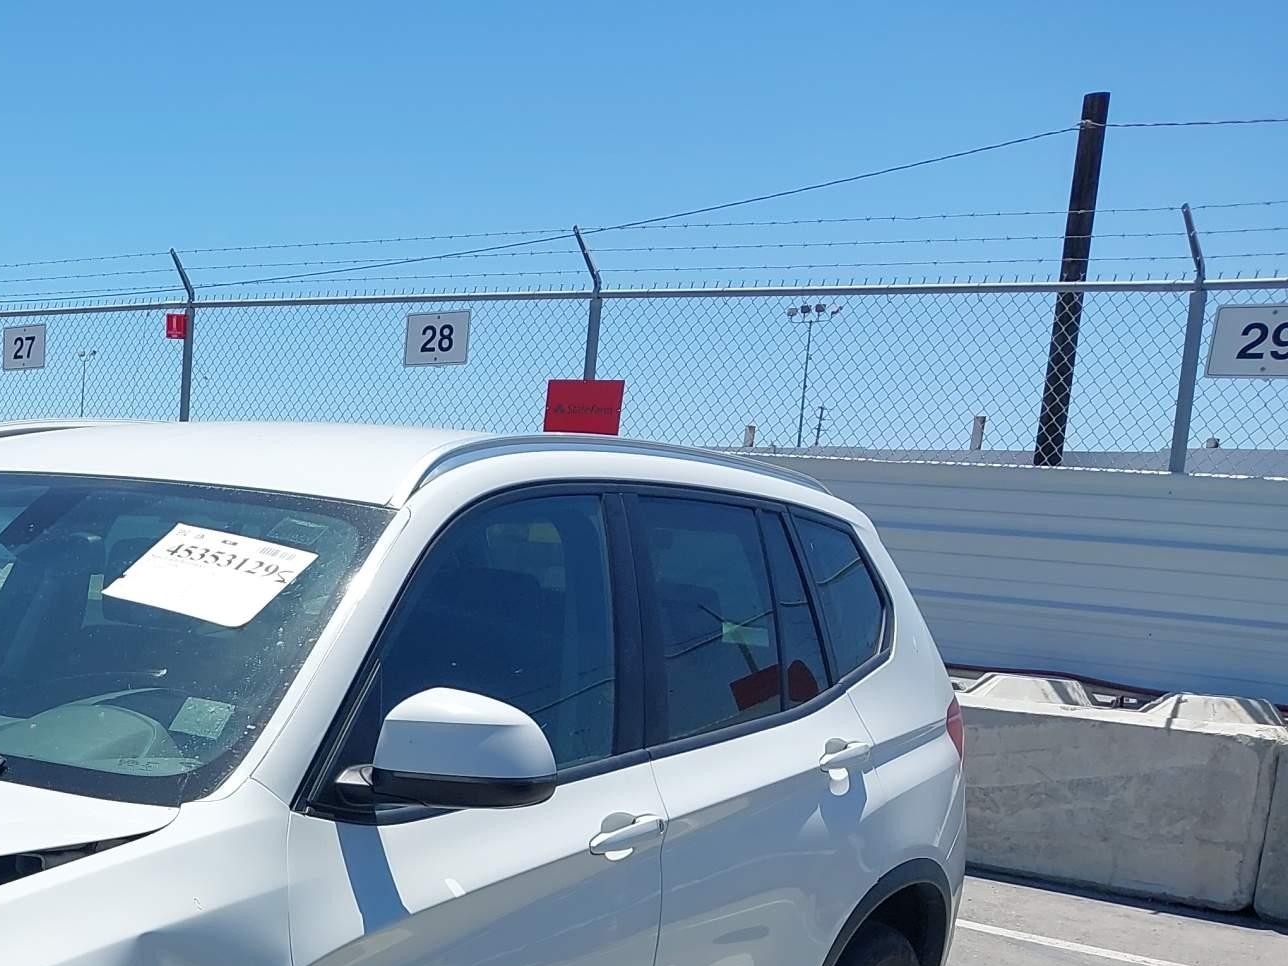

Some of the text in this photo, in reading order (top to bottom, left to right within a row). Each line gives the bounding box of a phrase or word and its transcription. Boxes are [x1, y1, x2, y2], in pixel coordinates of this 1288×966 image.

[13, 335, 36, 360] 27
[420, 324, 454, 353] 28
[166, 543, 279, 577] 45353129
